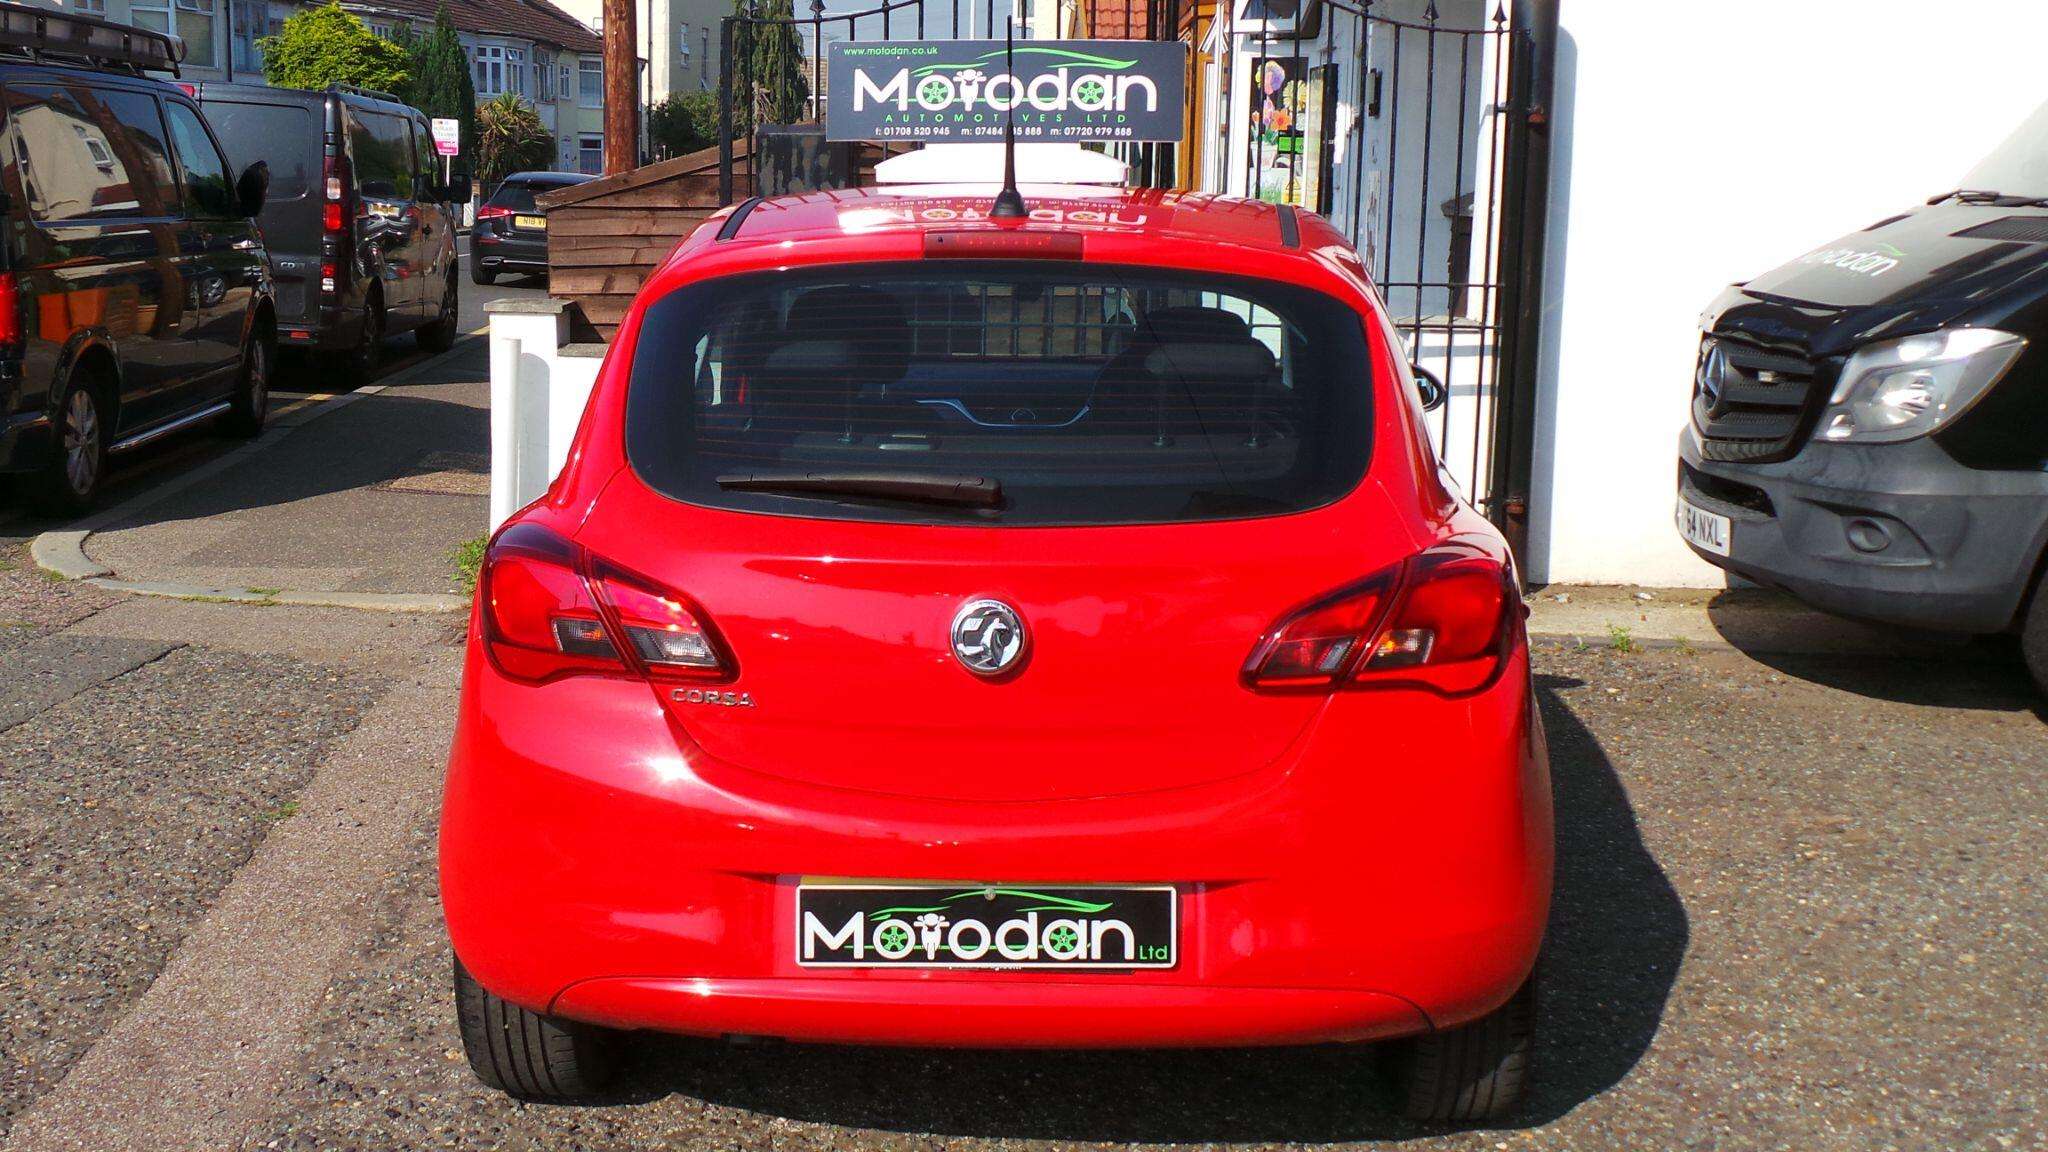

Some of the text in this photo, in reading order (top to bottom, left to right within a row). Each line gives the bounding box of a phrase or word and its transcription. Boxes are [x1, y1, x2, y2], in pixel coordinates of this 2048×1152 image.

[843, 46, 938, 56] www.motodan.co.uk
[853, 67, 1157, 112] Motodan
[885, 113, 1126, 123] AUTOMOTVES LTD
[884, 126, 911, 136] 01708
[914, 126, 931, 136] 520
[933, 126, 950, 136] 945
[961, 127, 972, 136] m:
[975, 126, 1003, 136] 07484
[1025, 126, 1042, 136] 888
[1050, 127, 1061, 136] m:
[1064, 126, 1092, 136] 07720
[1095, 126, 1112, 136] 979
[1699, 513, 1722, 547] NXL
[671, 688, 757, 707] CORSA
[804, 911, 1168, 961] Motodan Ltd
